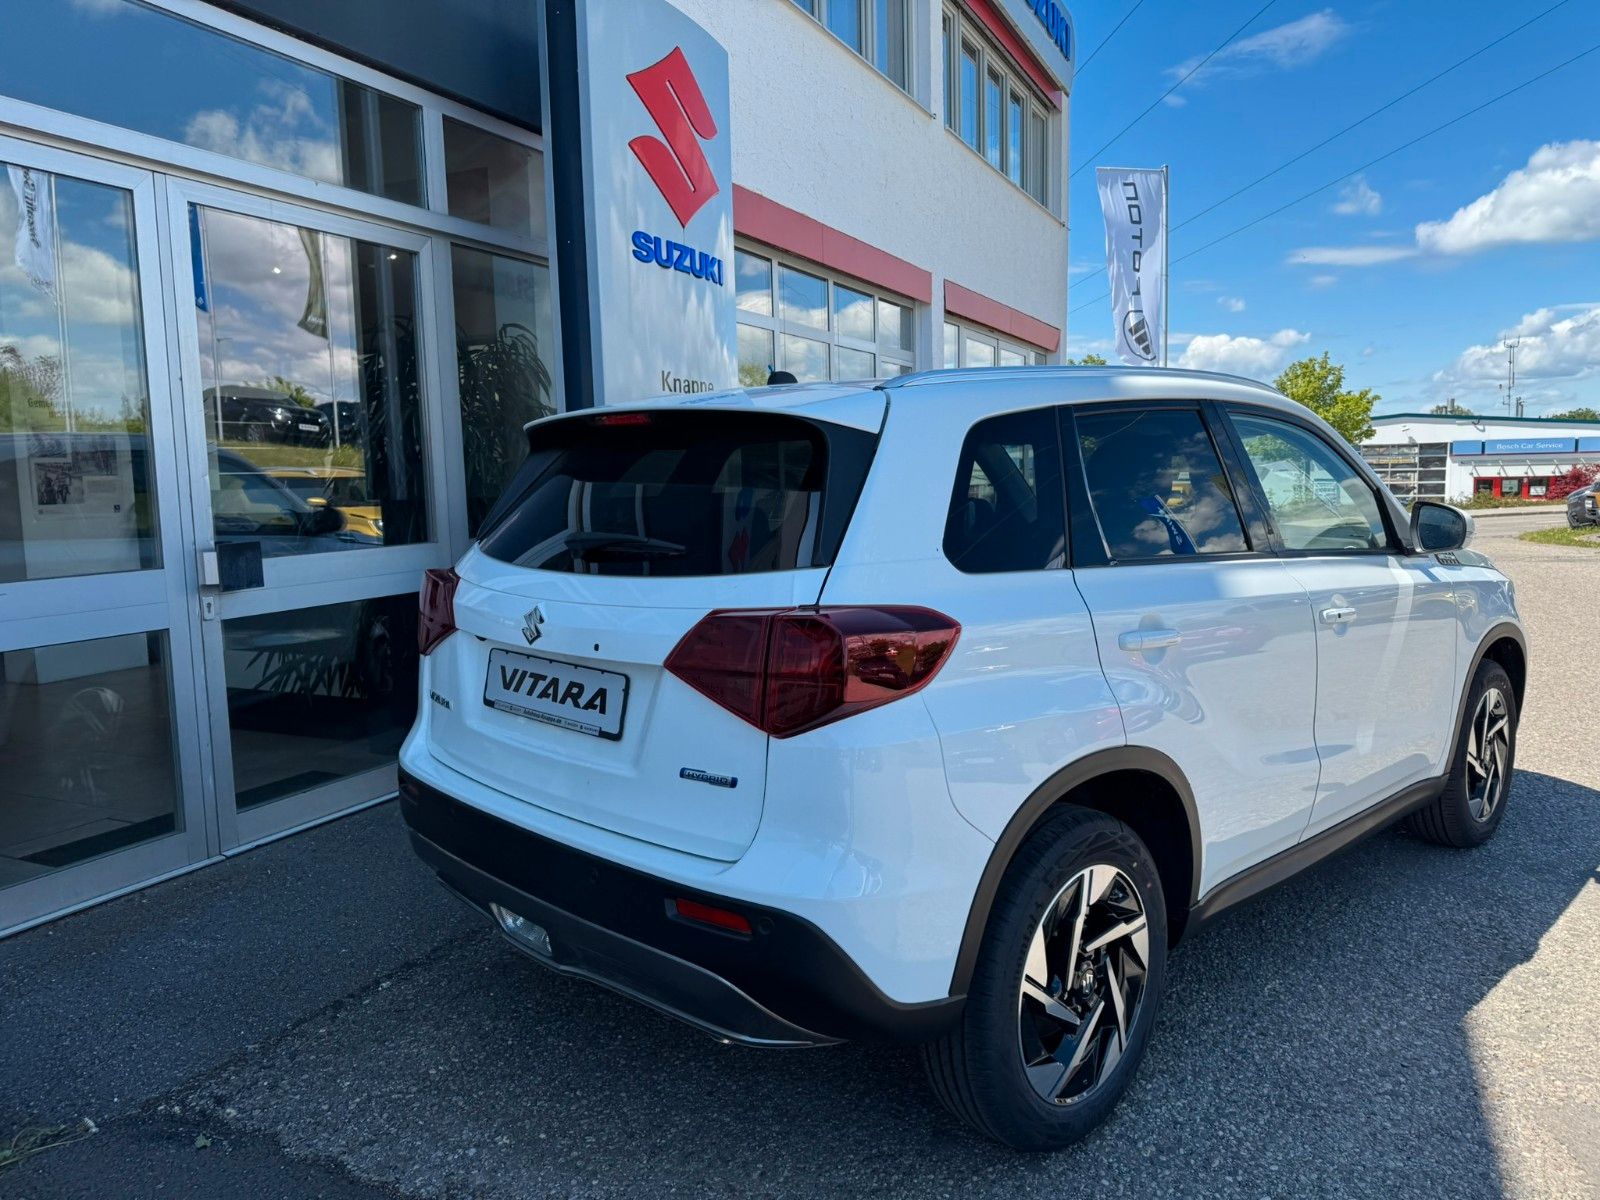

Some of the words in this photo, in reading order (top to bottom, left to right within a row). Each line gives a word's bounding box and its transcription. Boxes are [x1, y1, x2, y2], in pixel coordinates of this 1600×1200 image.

[631, 230, 724, 287] SUZUKI
[1496, 443, 1520, 451] Bosch
[1521, 442, 1534, 450] Car
[1536, 441, 1564, 450] Service
[499, 664, 608, 716] VITARA
[684, 769, 730, 787] HYBRID
